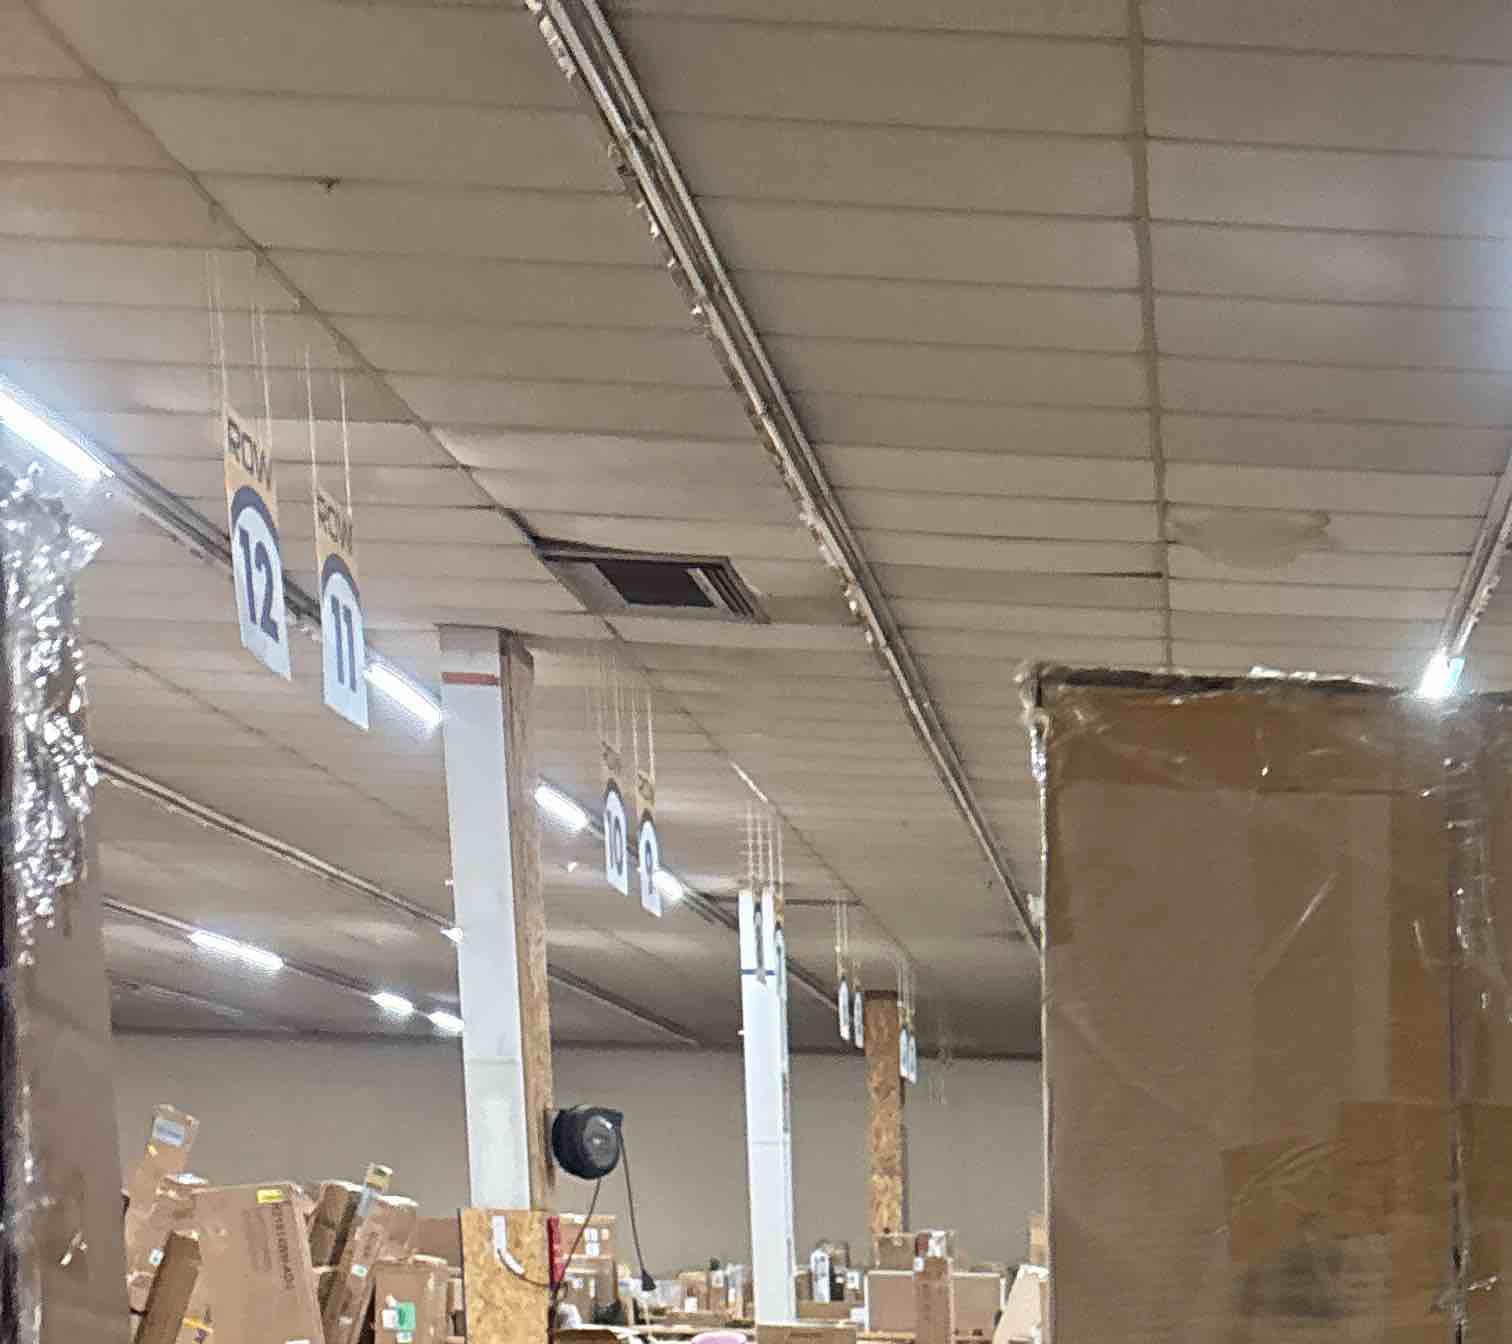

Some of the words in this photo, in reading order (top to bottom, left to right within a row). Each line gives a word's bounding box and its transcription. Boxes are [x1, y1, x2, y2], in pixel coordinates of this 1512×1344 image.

[226, 417, 273, 490] ROW
[238, 526, 281, 645] 12
[330, 594, 358, 693] 11
[605, 809, 624, 877] 10
